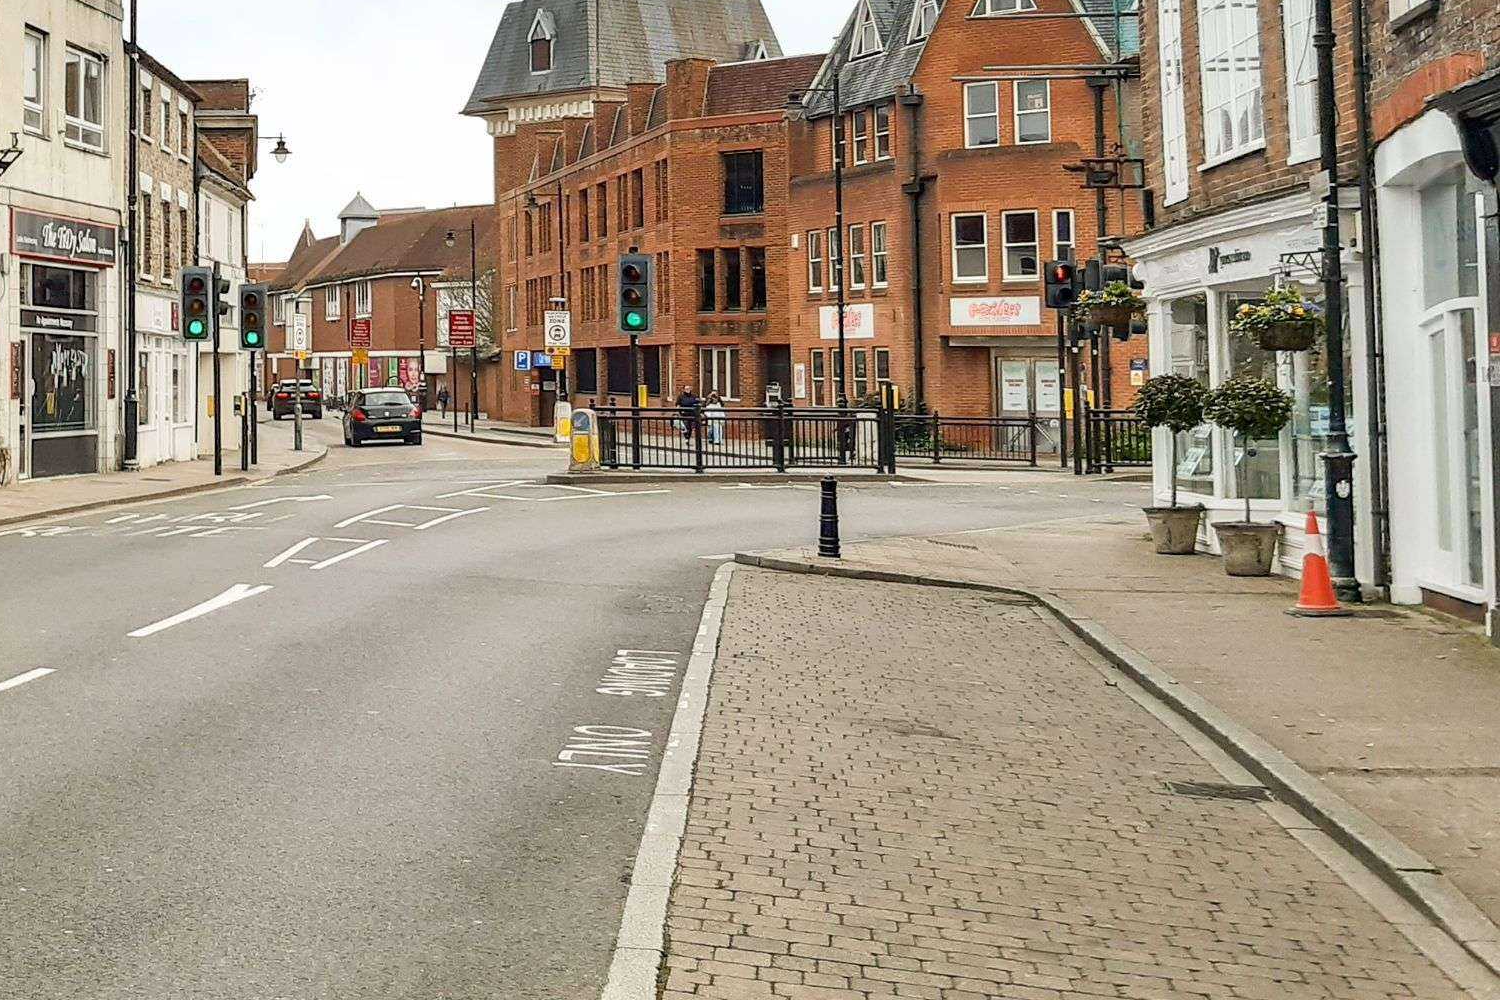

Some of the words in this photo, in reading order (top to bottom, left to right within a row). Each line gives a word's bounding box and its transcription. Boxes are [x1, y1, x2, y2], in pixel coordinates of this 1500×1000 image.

[42, 221, 57, 248] The
[76, 228, 97, 254] Salon
[595, 649, 681, 698] LOADING
[552, 724, 654, 776] ONLY
